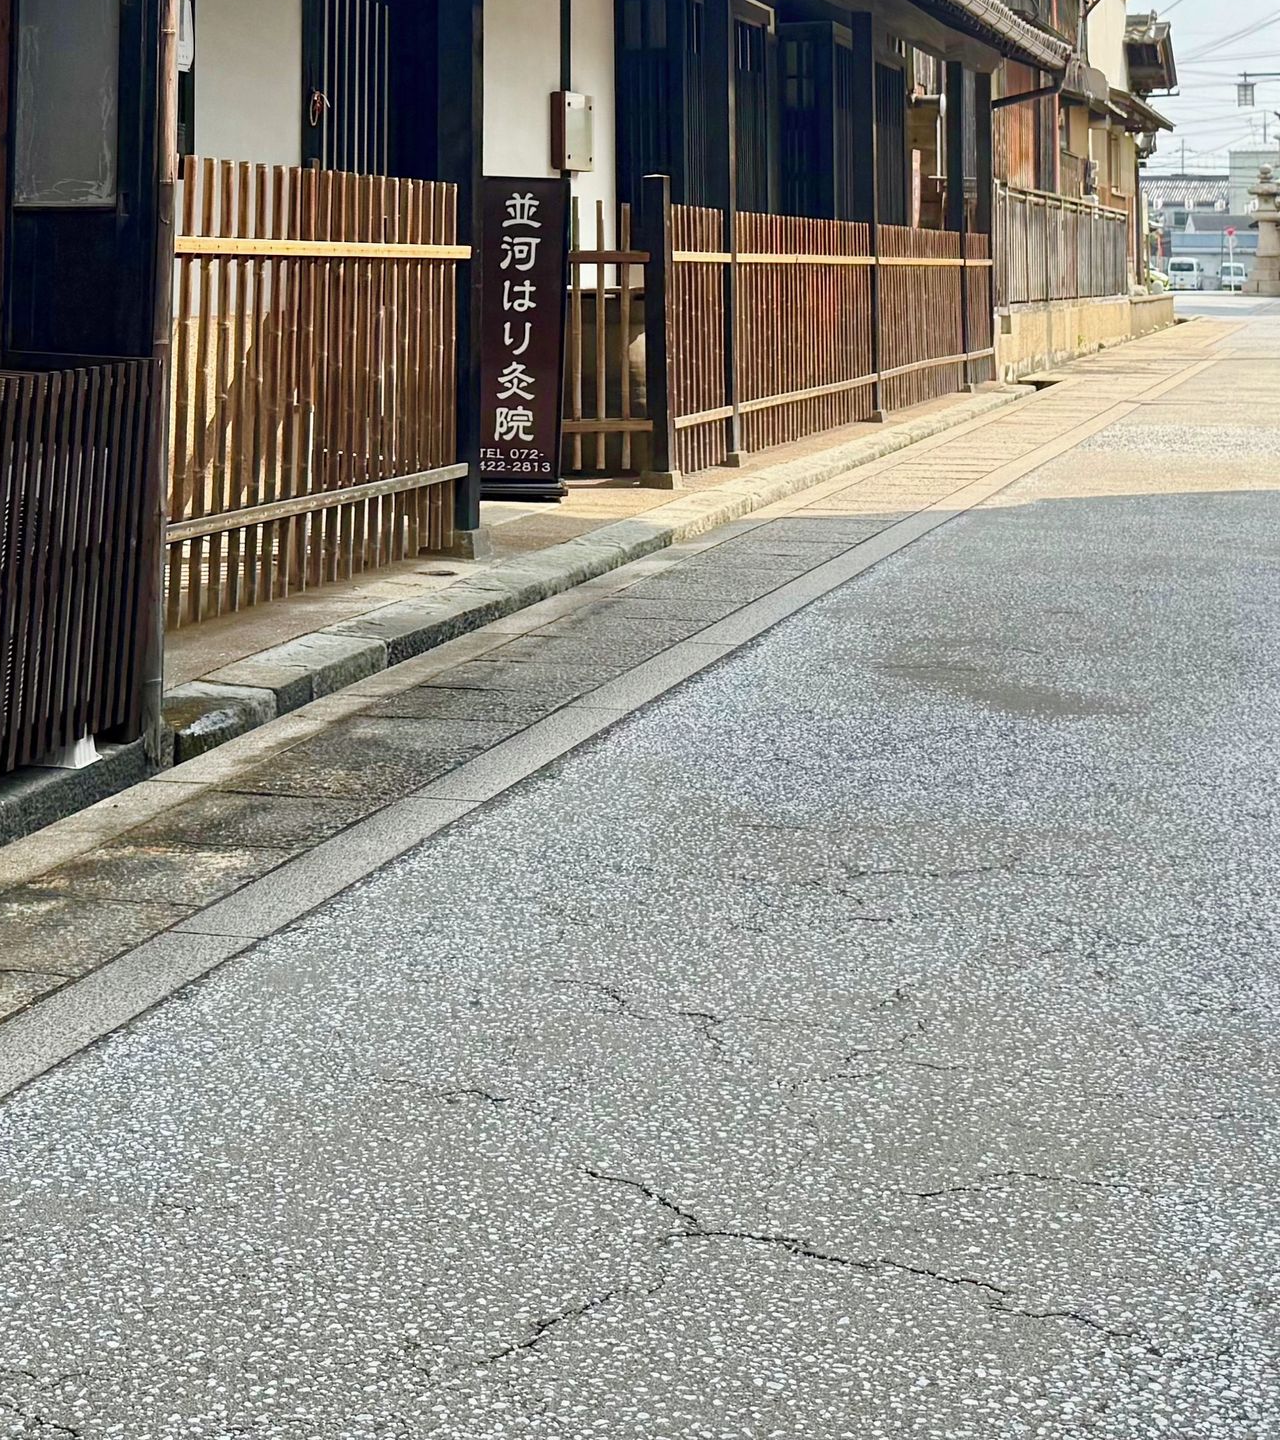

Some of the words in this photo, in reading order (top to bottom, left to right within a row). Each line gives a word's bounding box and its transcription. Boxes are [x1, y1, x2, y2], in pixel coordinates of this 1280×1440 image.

[494, 192, 542, 442] 並河はり灸院
[480, 448, 505, 459] TEL
[509, 448, 545, 460] 072-
[480, 460, 551, 472] 422-2813
